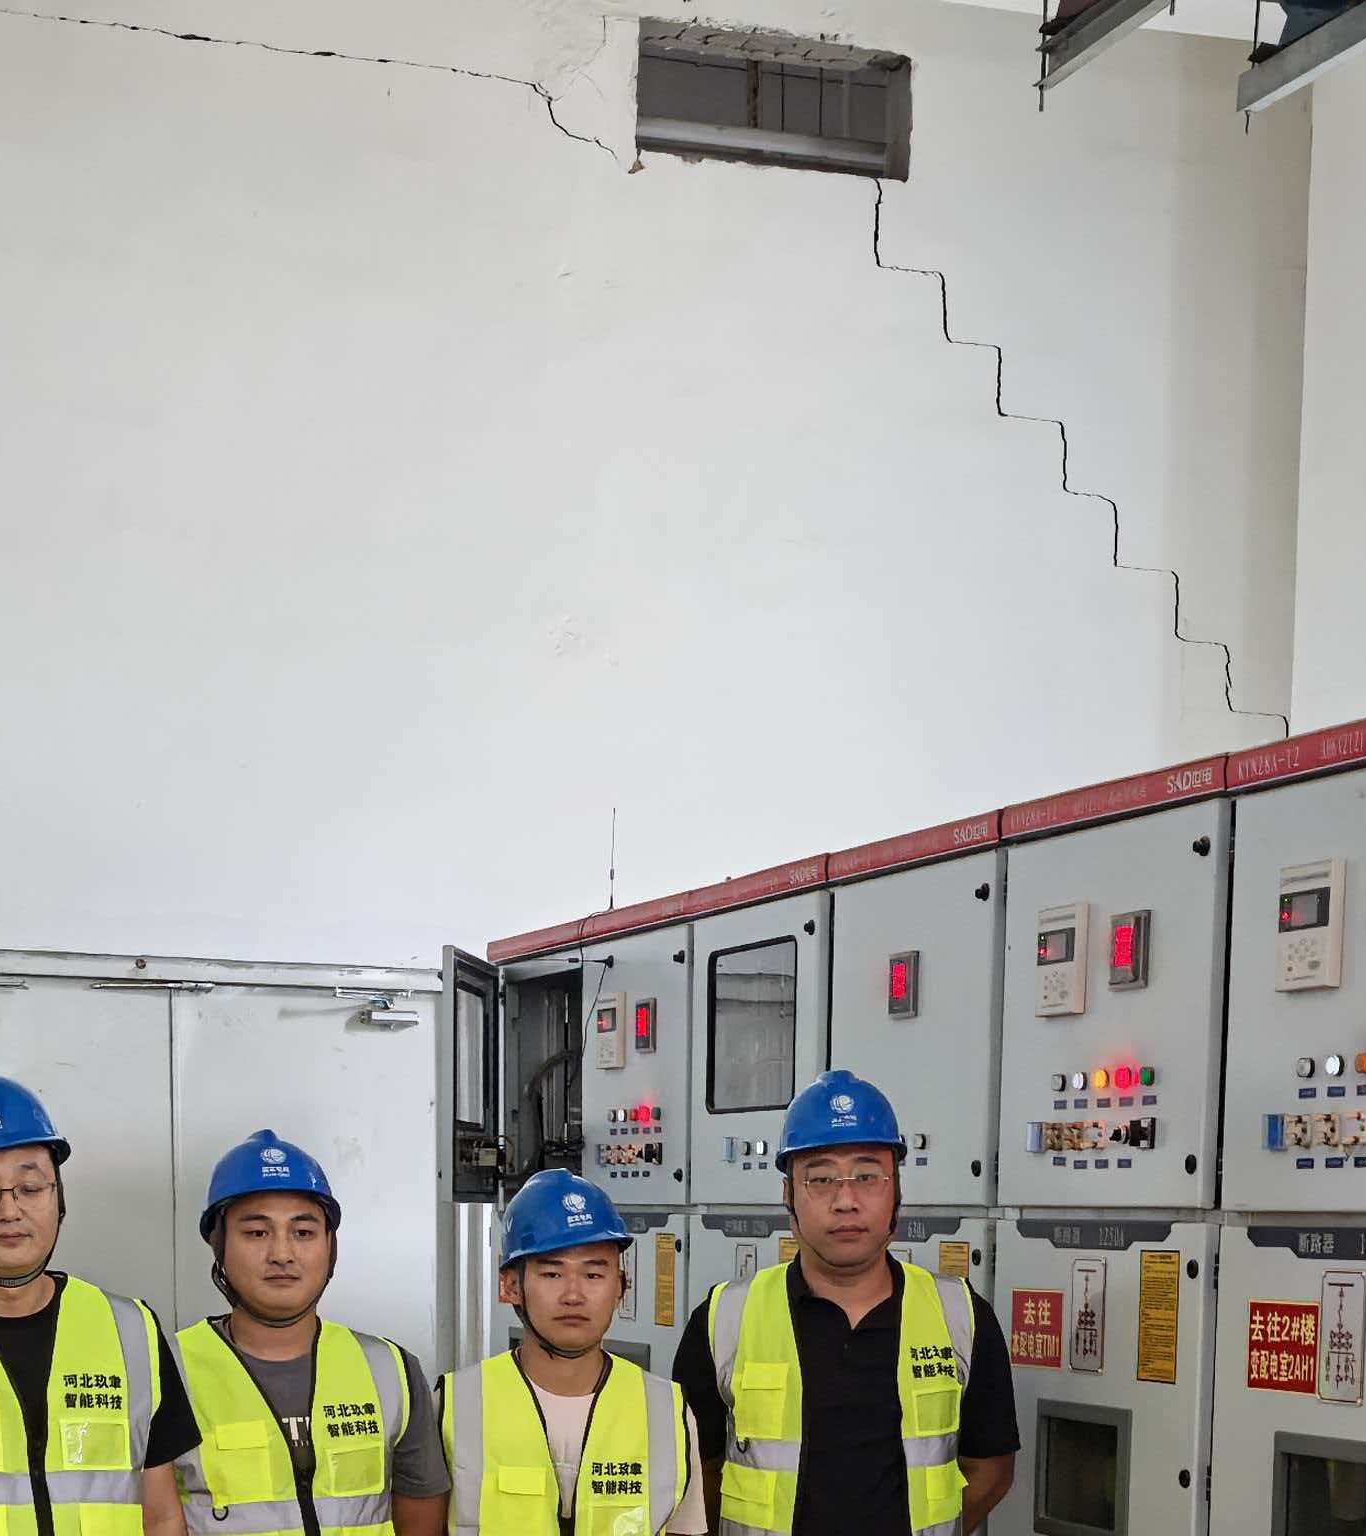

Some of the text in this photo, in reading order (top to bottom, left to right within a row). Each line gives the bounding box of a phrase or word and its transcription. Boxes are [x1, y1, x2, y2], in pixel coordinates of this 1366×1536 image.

[1250, 1310, 1316, 1346] 去往2#楼
[1250, 1348, 1314, 1382] 变配电室2AH1
[65, 1393, 123, 1410] 智能科技
[326, 1420, 380, 1438] 智能科技
[592, 1480, 643, 1495] 智能科技
